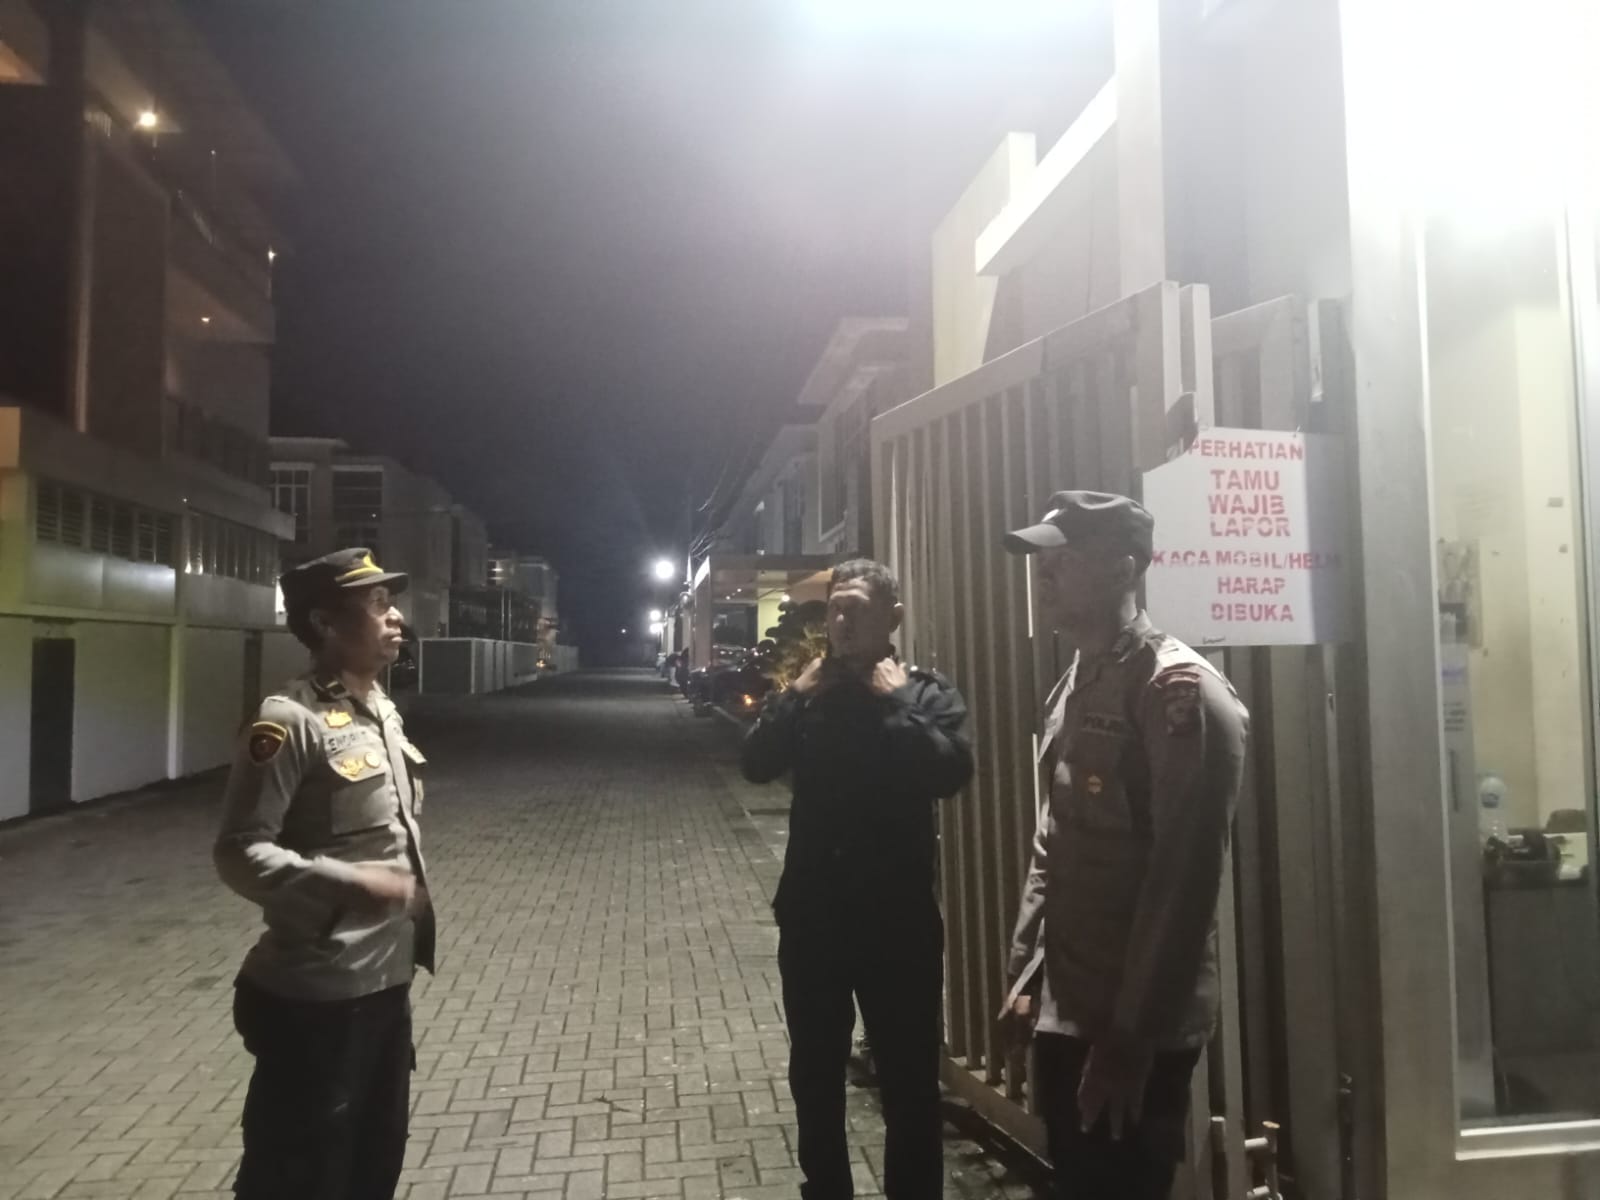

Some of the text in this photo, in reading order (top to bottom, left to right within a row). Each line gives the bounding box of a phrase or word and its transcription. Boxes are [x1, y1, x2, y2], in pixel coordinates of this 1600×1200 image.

[1188, 439, 1304, 461] PERHATIAN
[1210, 469, 1280, 491] TAMU
[1208, 494, 1286, 515] WAJIB
[1210, 516, 1291, 537] LAPOR
[1151, 550, 1211, 567] KACA
[1217, 576, 1286, 595] HARAP
[1211, 603, 1294, 622] DIBUKA
